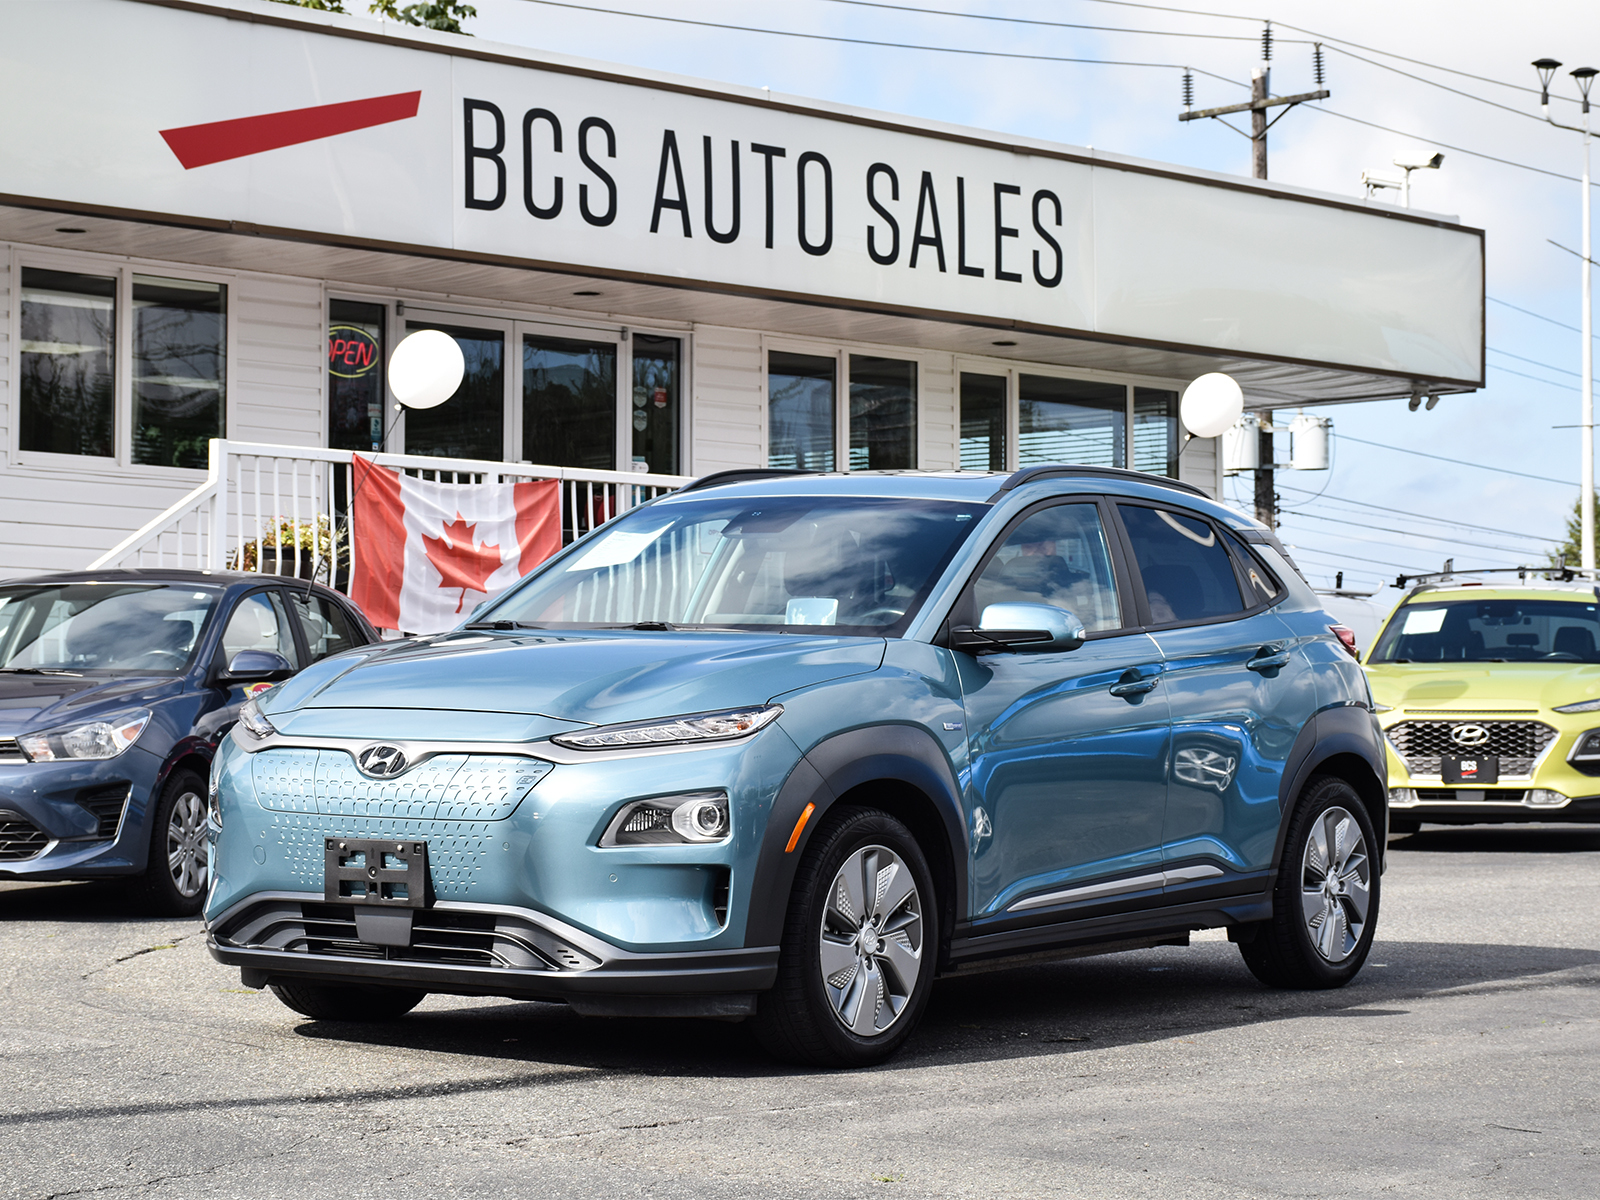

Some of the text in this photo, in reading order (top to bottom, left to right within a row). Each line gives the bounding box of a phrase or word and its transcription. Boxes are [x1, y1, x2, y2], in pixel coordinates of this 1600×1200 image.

[463, 97, 1063, 289] BCS AUTO SALES
[1460, 760, 1477, 771] BCS
